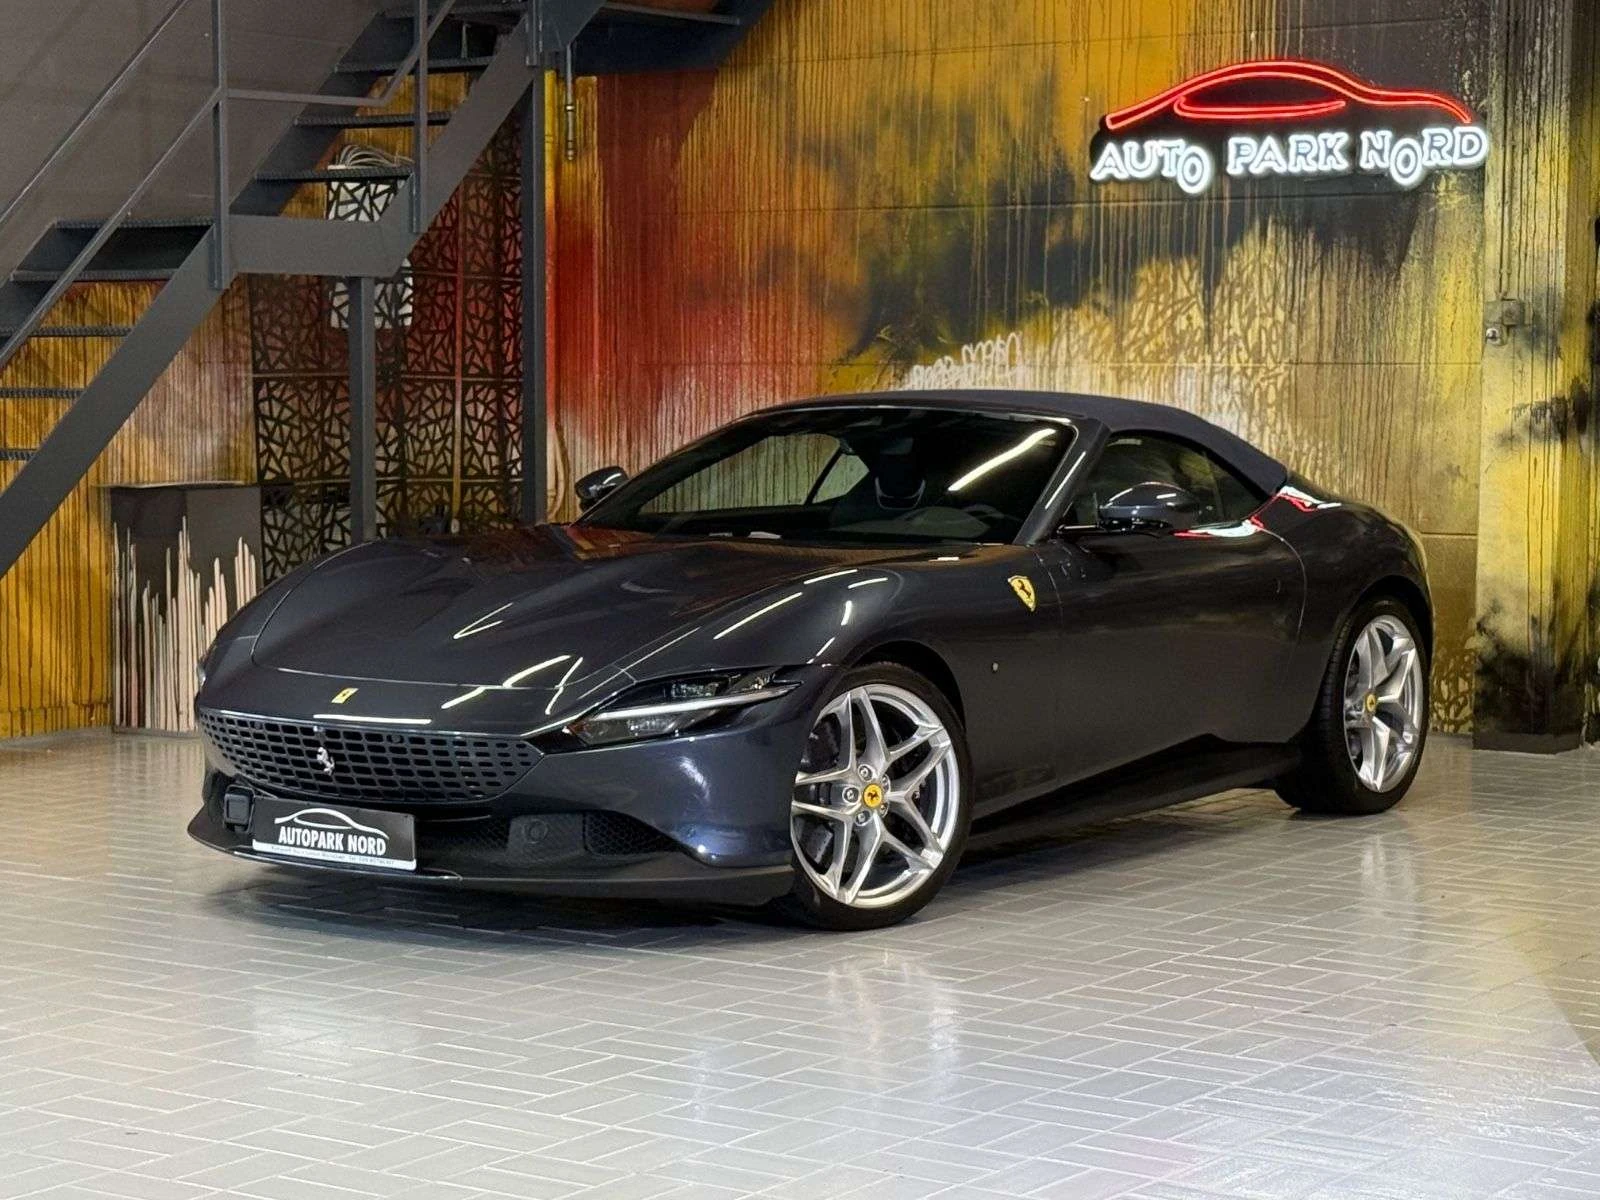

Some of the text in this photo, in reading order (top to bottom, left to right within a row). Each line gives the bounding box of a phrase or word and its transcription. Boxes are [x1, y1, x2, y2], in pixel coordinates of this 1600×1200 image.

[1090, 127, 1488, 194] AUTO PARK NORD
[278, 826, 344, 852] AUTOPARK
[347, 834, 387, 856] NORD
